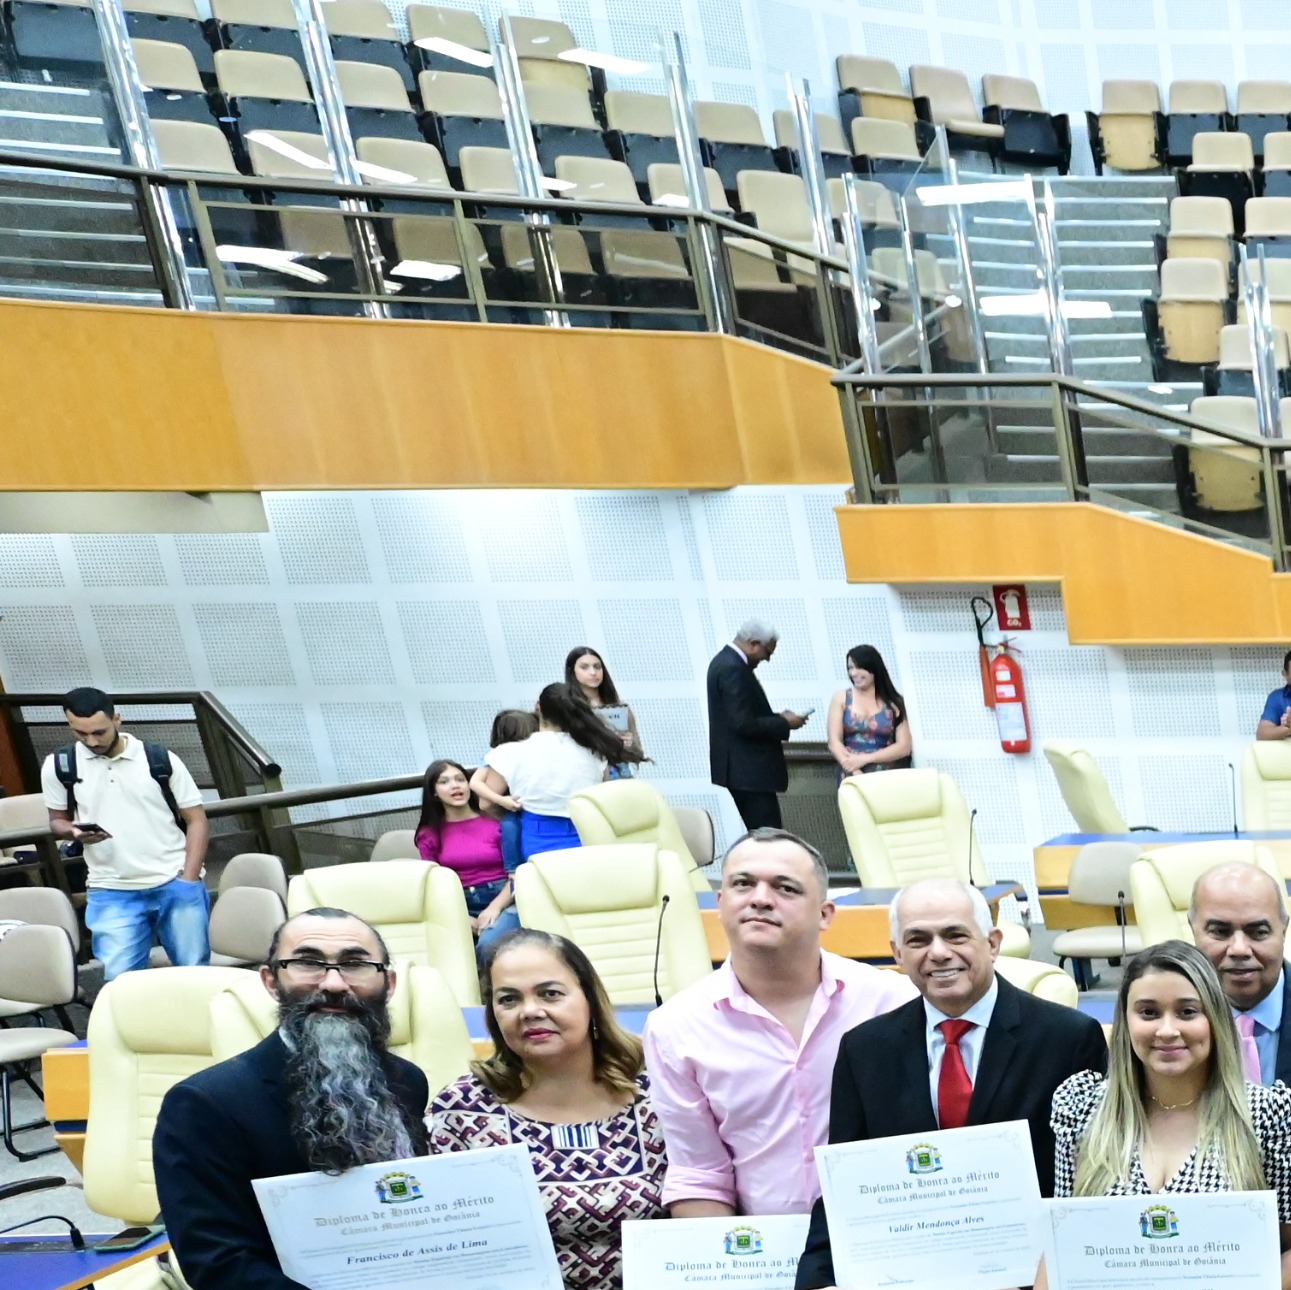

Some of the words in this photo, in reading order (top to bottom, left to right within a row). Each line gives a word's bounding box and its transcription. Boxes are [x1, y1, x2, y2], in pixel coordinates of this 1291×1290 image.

[858, 1183, 900, 1194] Diploma
[902, 1180, 913, 1189] de
[916, 1177, 949, 1188] Honra
[951, 1176, 963, 1184] ao
[966, 1171, 1000, 1183] Mérito
[313, 1214, 369, 1227] Diploma
[371, 1211, 386, 1219] de
[389, 1205, 431, 1217] Honra
[434, 1203, 448, 1211] ao
[452, 1196, 494, 1210] Mérito
[339, 1225, 378, 1236] Câmara
[381, 1217, 429, 1230] Municipal
[430, 1216, 441, 1224] de
[443, 1211, 480, 1222] Goiânia
[889, 1223, 913, 1233] Valdir
[917, 1219, 960, 1229] Mendonça
[964, 1215, 984, 1224] Alves
[347, 1252, 399, 1265] Francisco
[402, 1249, 414, 1257] de
[418, 1245, 443, 1255] Assis
[445, 1242, 458, 1251] de
[461, 1240, 487, 1249] Lima
[1083, 1245, 1130, 1257] Diploma
[1133, 1244, 1145, 1254] de
[1149, 1243, 1184, 1254] Honra
[1187, 1244, 1199, 1253] ao
[1203, 1240, 1240, 1253] Mérito
[664, 1262, 712, 1272] Diploma
[715, 1261, 726, 1269] de
[732, 1259, 766, 1268] Honra
[1104, 1259, 1137, 1268] Câmara
[1139, 1258, 1180, 1268] Municipal
[1182, 1258, 1191, 1266] de
[1193, 1256, 1226, 1265] Goiânia
[776, 1270, 796, 1279] Goiâ
